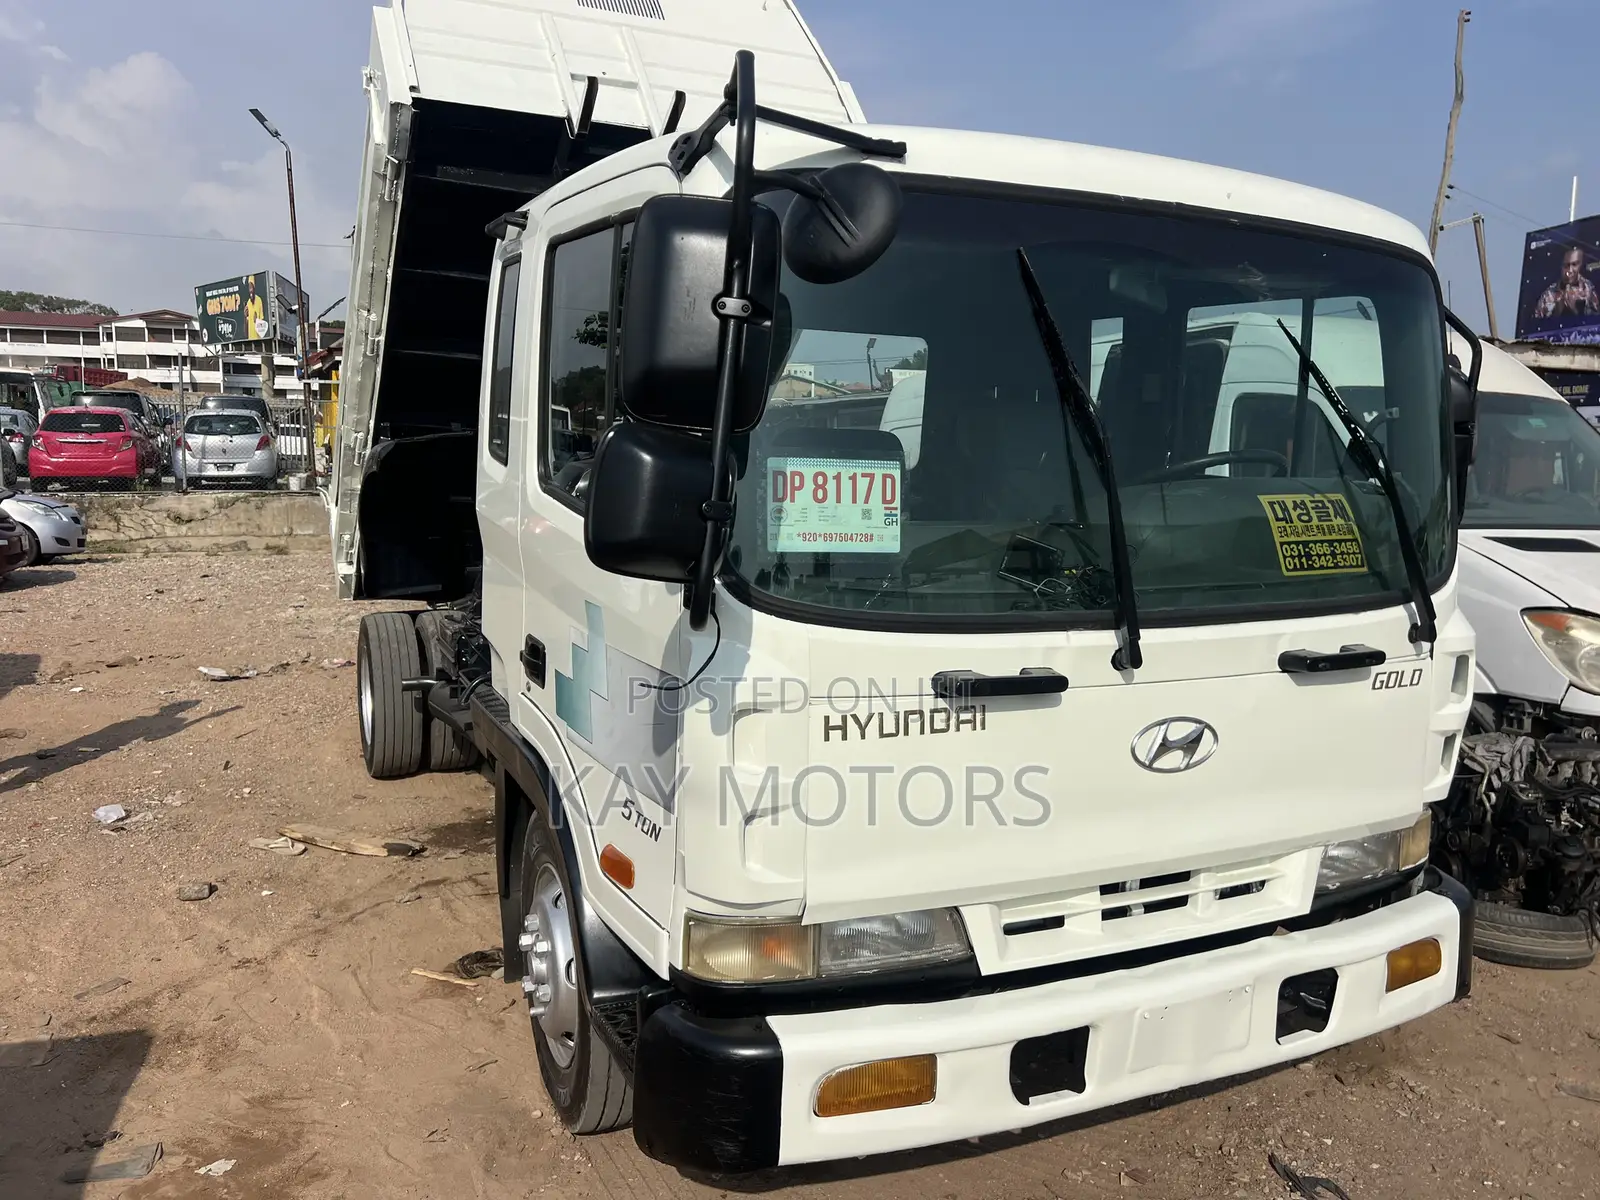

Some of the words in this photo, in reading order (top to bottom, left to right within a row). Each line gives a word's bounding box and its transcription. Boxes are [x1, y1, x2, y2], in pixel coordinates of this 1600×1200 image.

[772, 470, 805, 504] DP
[812, 471, 875, 505] 8117
[881, 473, 897, 504] D
[884, 518, 898, 526] GH
[1282, 542, 1360, 557] 031-366-3458
[1285, 554, 1361, 570] 011-342-5307
[1371, 668, 1423, 691] GOLD
[824, 704, 987, 743] HYUNDAI
[621, 797, 635, 821] 5
[635, 810, 661, 842] TON
